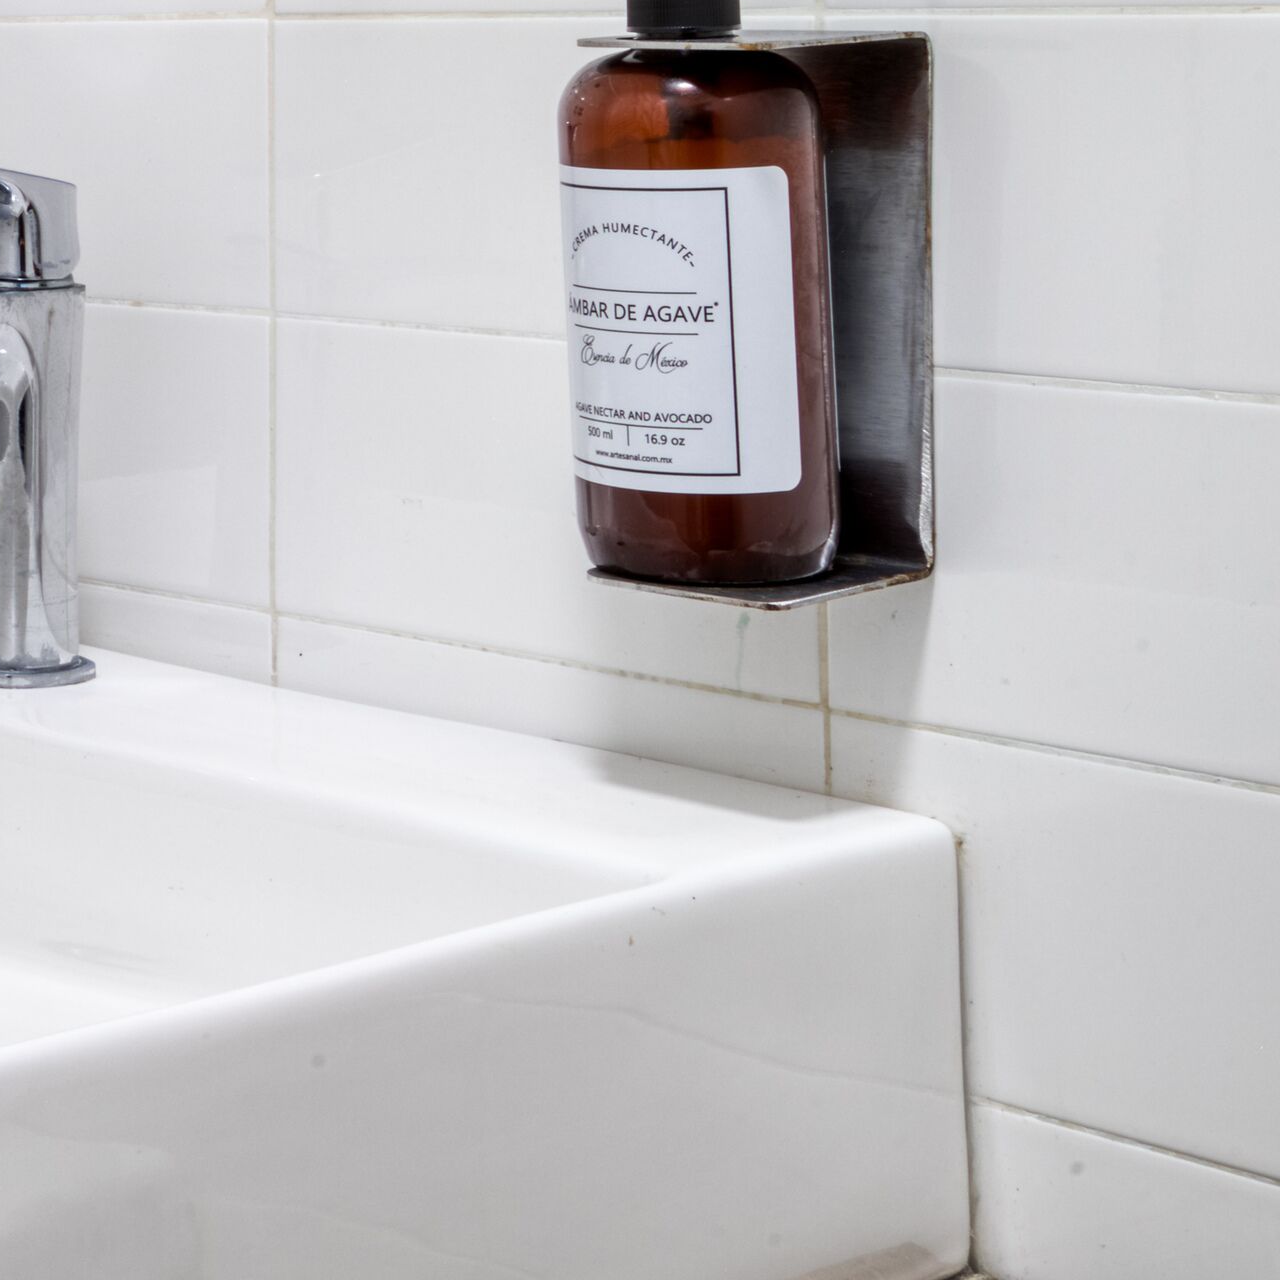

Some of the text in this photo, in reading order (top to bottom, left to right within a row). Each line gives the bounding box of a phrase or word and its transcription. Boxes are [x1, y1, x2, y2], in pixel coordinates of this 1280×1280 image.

[572, 222, 694, 261] CREMA HUMECTANTE
[614, 303, 637, 321] DE
[619, 344, 633, 365] de
[635, 342, 689, 374] México
[576, 402, 713, 424] AGAVE NECTAR AND AVOCADO
[588, 425, 613, 440] 500 ml
[645, 434, 686, 446] 16.9 oz
[595, 449, 673, 464] www.artesanal.com.mx
